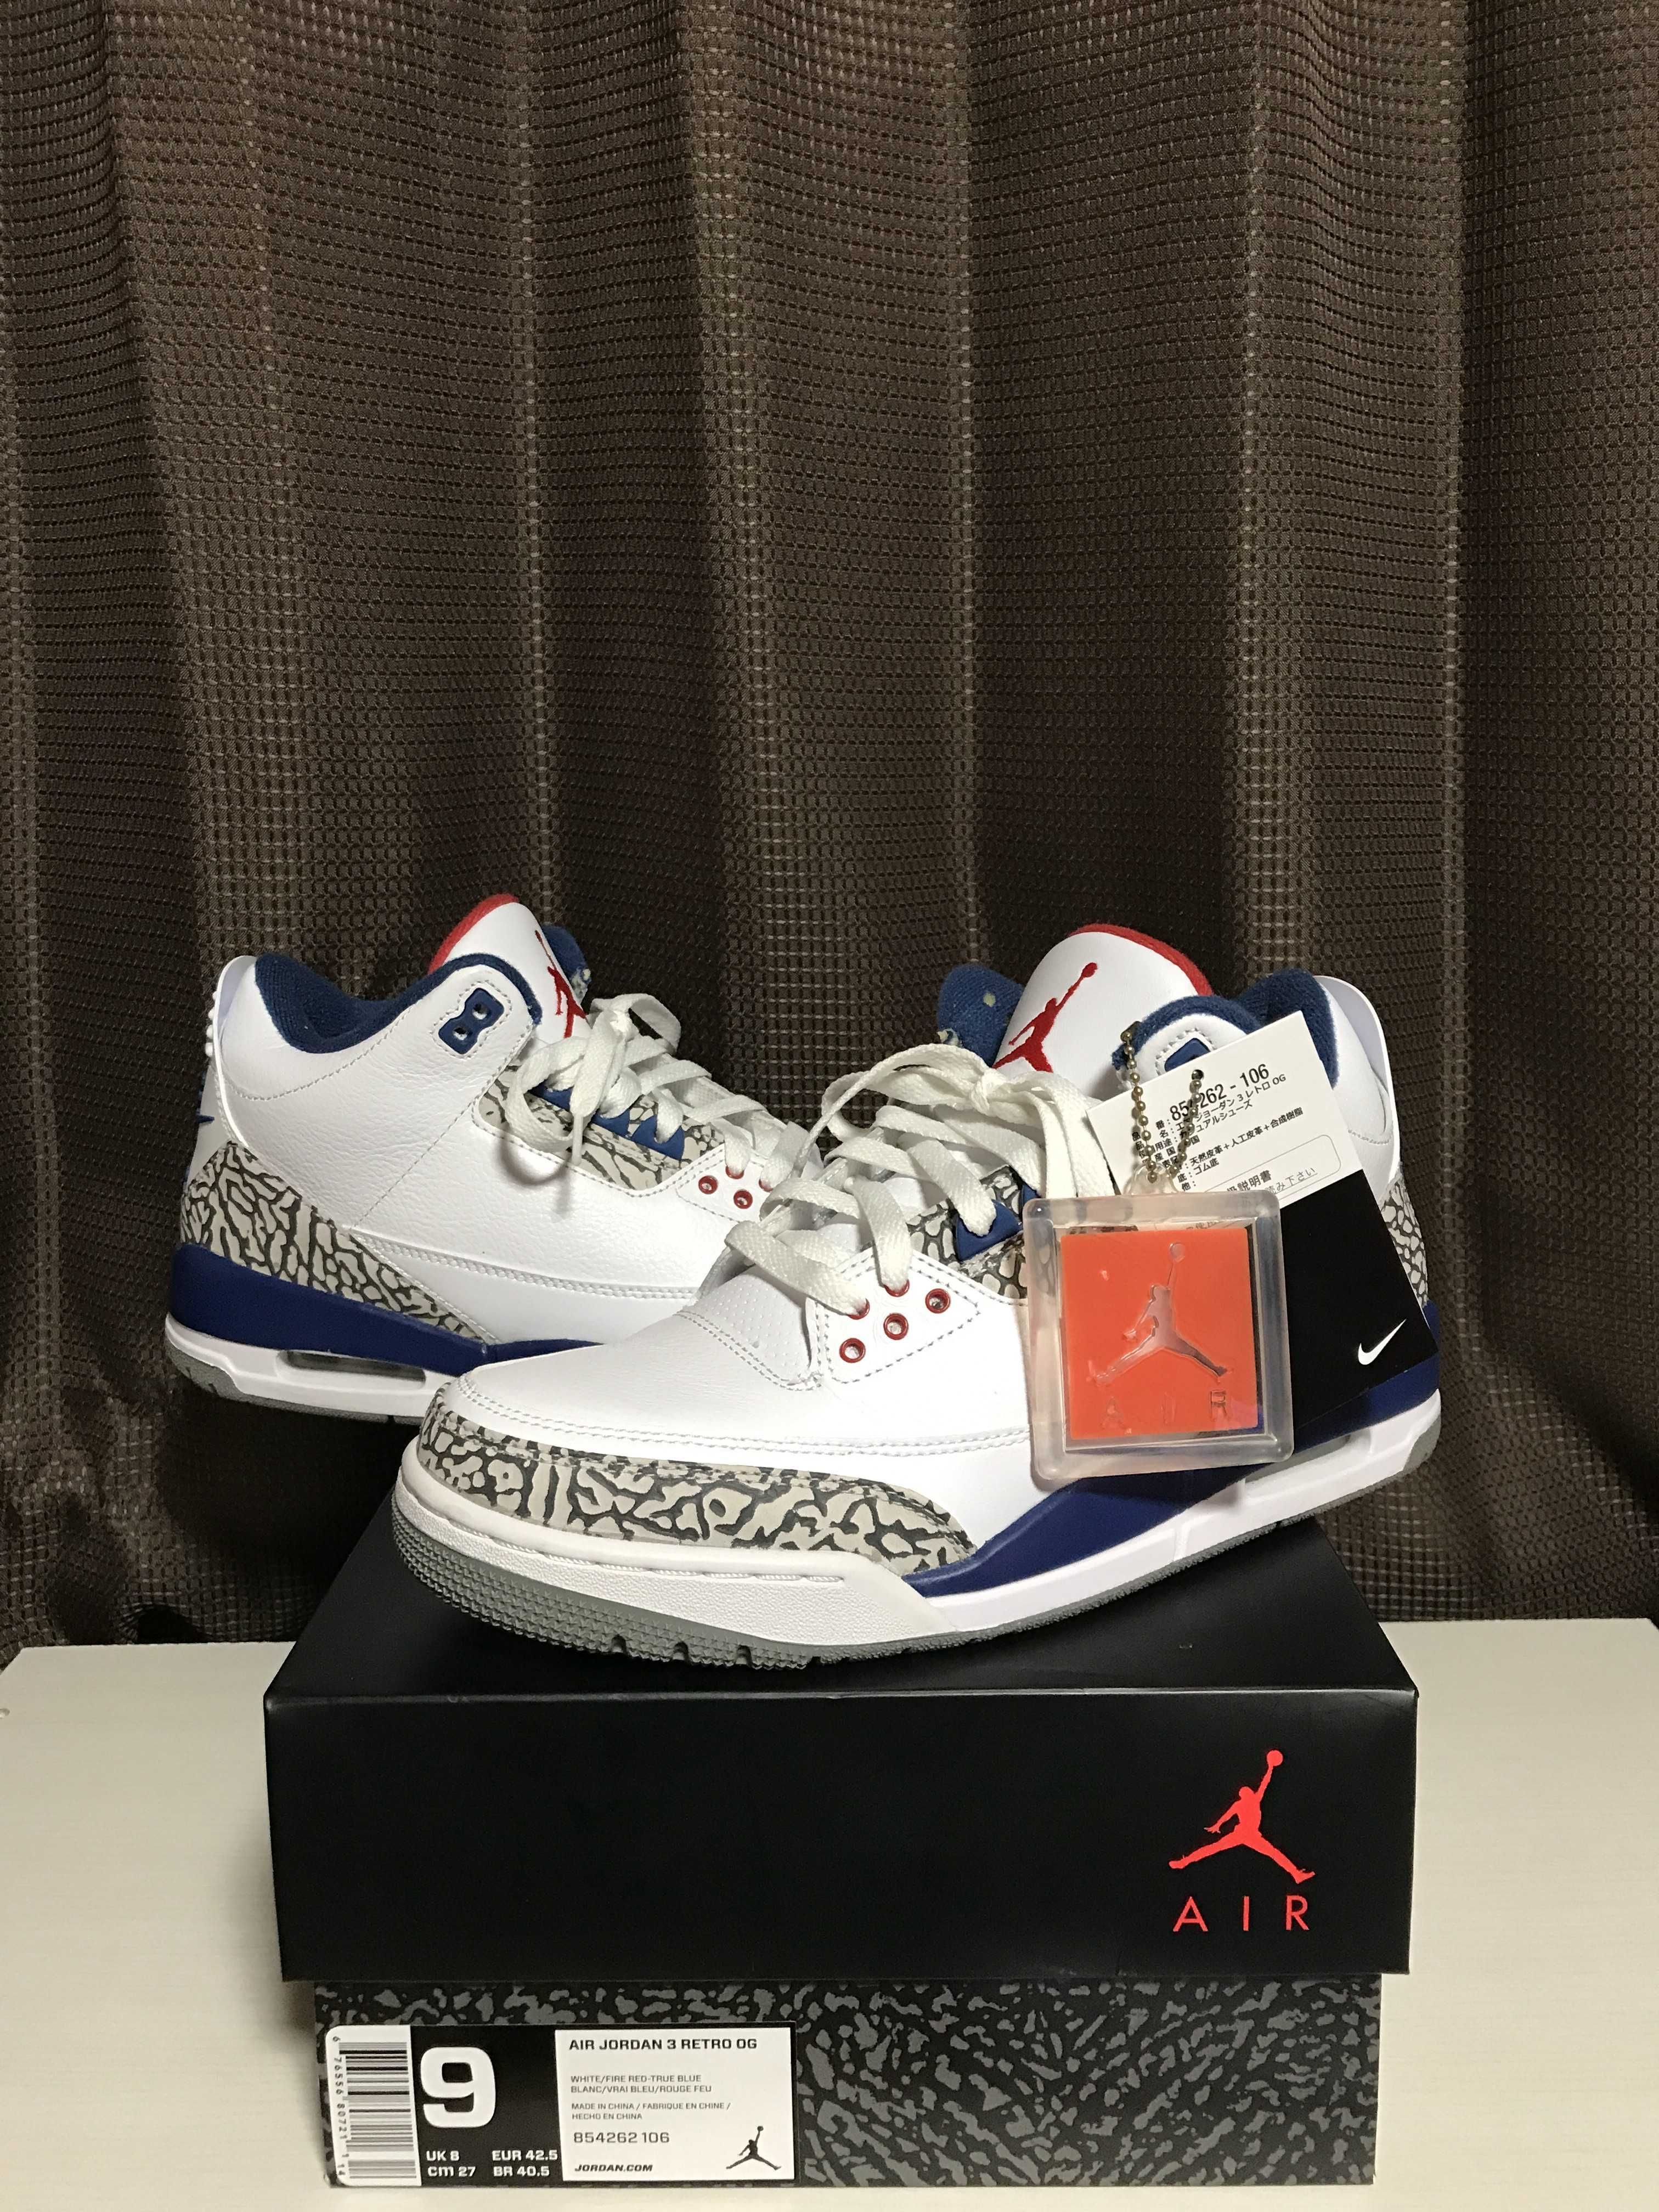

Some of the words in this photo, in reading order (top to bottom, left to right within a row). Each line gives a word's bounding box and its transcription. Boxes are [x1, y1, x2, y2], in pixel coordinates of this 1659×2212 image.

[1239, 1063, 1269, 1087] 106
[1172, 1894, 1310, 1932] AIR
[569, 2039, 595, 2050] AIR
[599, 2039, 662, 2050] JORDAN
[667, 2039, 676, 2050] 3
[681, 2039, 732, 2050] RETRO
[736, 2038, 757, 2049] OG
[571, 2075, 626, 2084] WHITE/FIRE
[628, 2075, 675, 2083] RED-TRUE
[420, 2047, 496, 2128] 9
[571, 2085, 628, 2094] BLANC/VRAI
[630, 2085, 691, 2094] BLEU/ROUGE
[642, 2102, 684, 2111] FABRIQUE
[699, 2102, 725, 2110] CHINE
[574, 2132, 637, 2143] 854262
[641, 2131, 670, 2143] 106
[426, 2150, 447, 2162] UK
[450, 2150, 460, 2162] 8
[492, 2149, 522, 2162] EUR
[526, 2149, 558, 2161] 42.5
[458, 2166, 476, 2177] 27
[493, 2166, 514, 2177] BR
[517, 2165, 550, 2177] 40.5
[574, 2164, 653, 2172] JORDAN.COM
